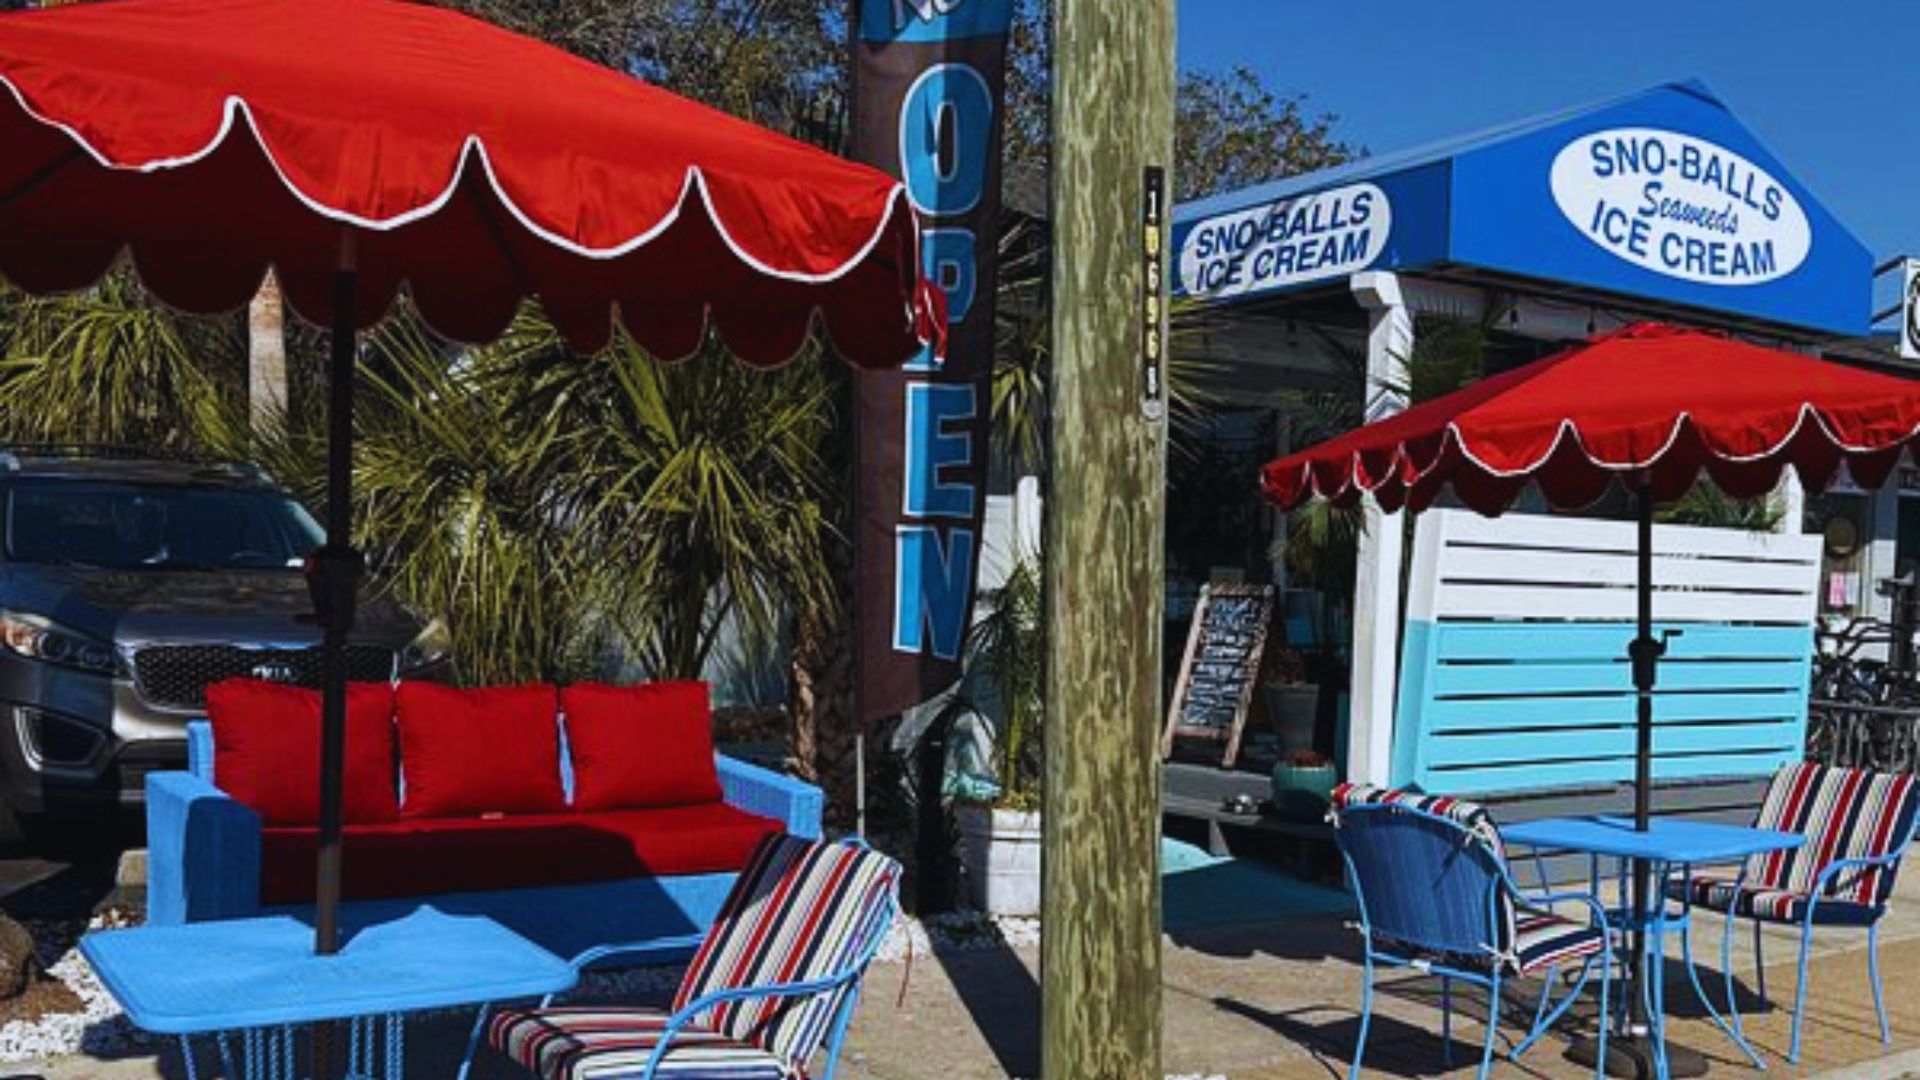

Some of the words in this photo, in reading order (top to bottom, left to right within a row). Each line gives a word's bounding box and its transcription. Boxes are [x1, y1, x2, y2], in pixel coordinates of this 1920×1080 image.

[1590, 137, 1783, 221] SNO-BALLS
[1638, 181, 1739, 234] Seaweeds
[1196, 191, 1373, 259] SNO-BALLS
[1197, 254, 1245, 291] ICE
[1253, 229, 1371, 281] CREAM
[1590, 200, 1652, 257] ICE
[1660, 233, 1776, 277] CREAM
[893, 62, 993, 663] OPEN
